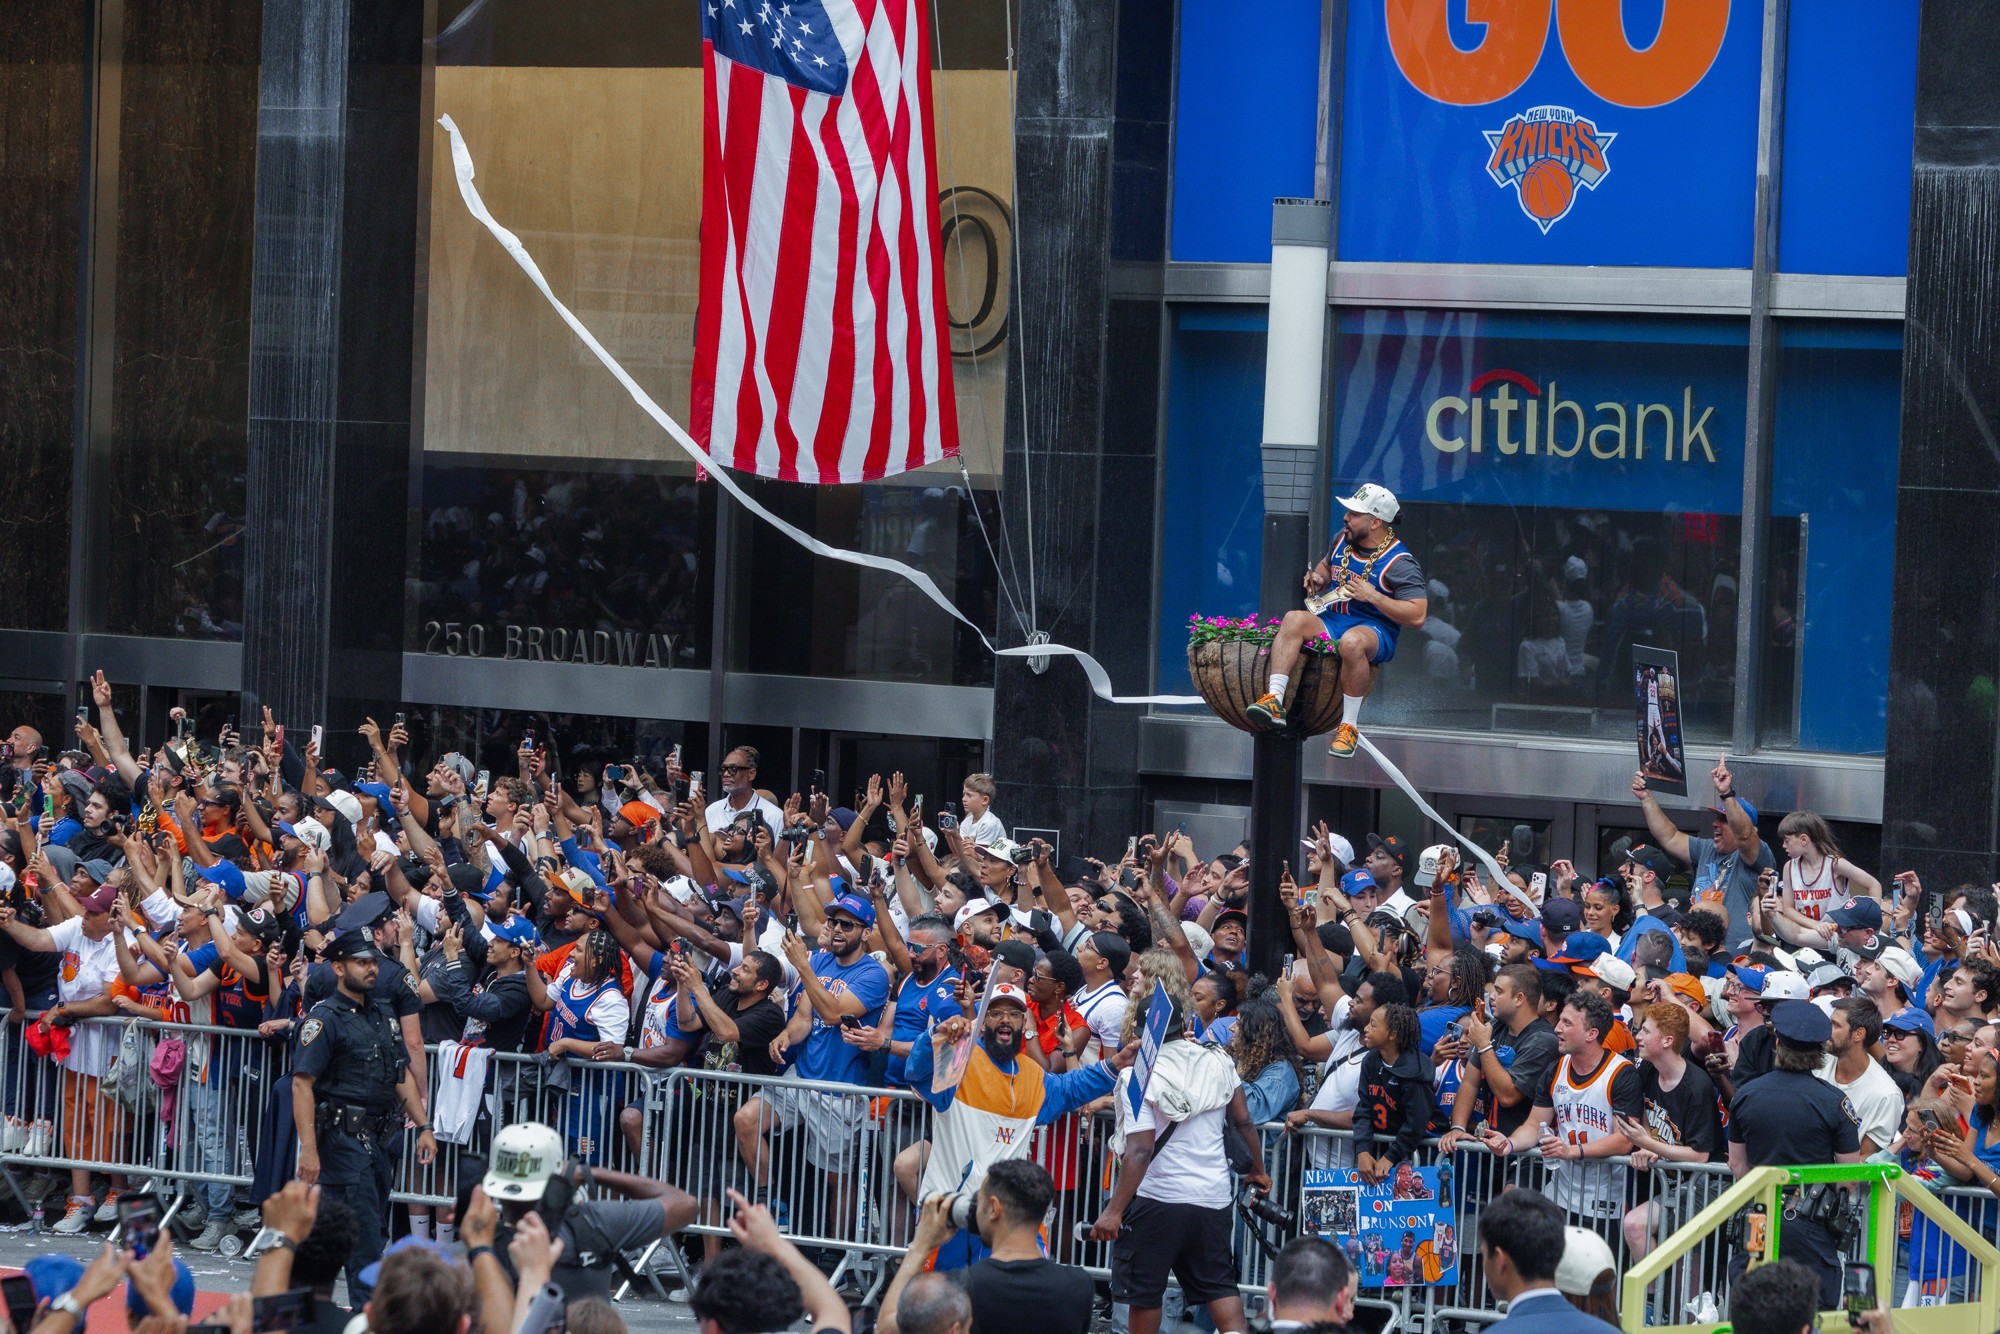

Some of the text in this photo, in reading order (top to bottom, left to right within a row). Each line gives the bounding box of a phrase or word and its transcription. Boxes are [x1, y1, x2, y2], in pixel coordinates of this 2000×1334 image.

[1527, 108, 1574, 123] NEW YORK
[1490, 120, 1606, 174] KNICKS
[1426, 377, 1716, 463] citibank
[425, 621, 680, 670] 250 BROADWAY
[1373, 1103, 1387, 1130] 3
[1576, 1103, 1608, 1133] YORK
[1568, 1130, 1588, 1145] 11
[1305, 1170, 1335, 1184] NEW
[1358, 1182, 1393, 1198] RUNS
[1373, 1200, 1393, 1213] ON
[1360, 1213, 1435, 1230] BRUNSON!
